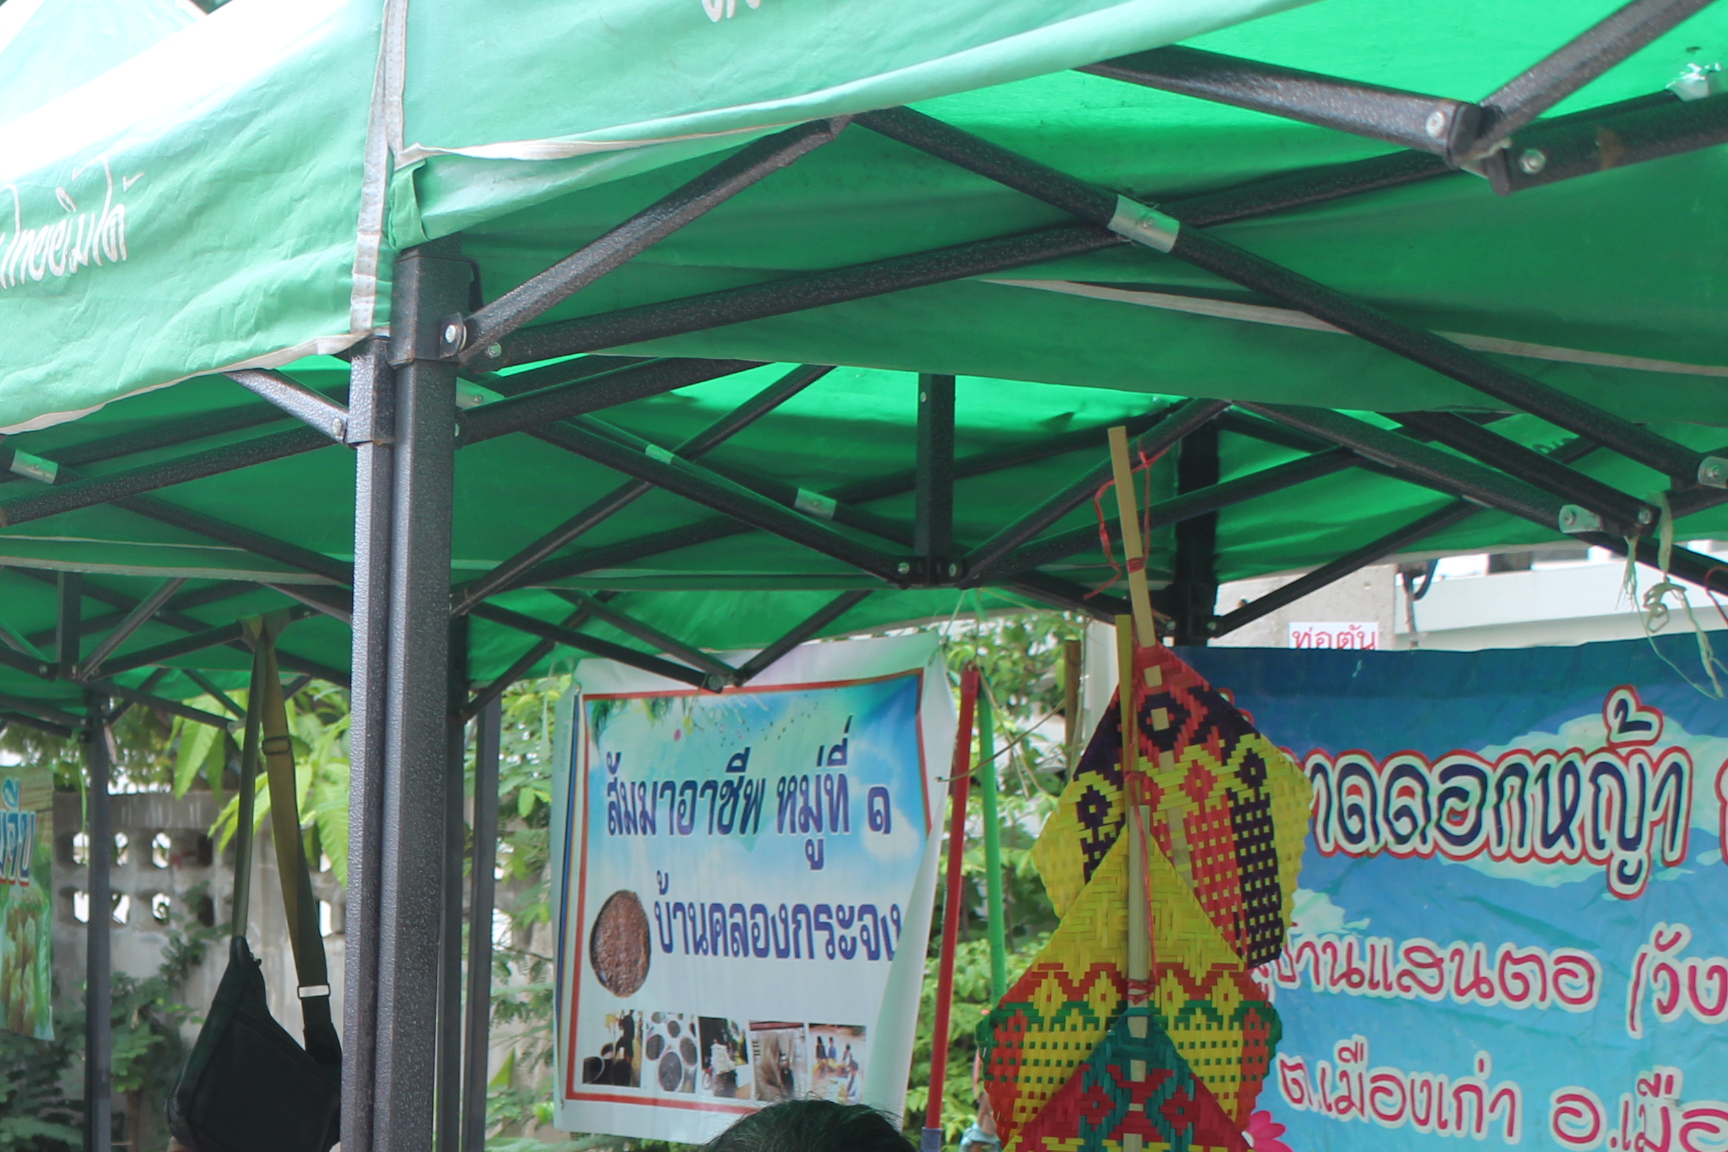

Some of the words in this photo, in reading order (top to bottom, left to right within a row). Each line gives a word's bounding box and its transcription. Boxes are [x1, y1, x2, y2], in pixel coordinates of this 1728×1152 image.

[606, 746, 767, 837] สัมมาอาชีพ
[775, 714, 854, 871] หมู่ที่
